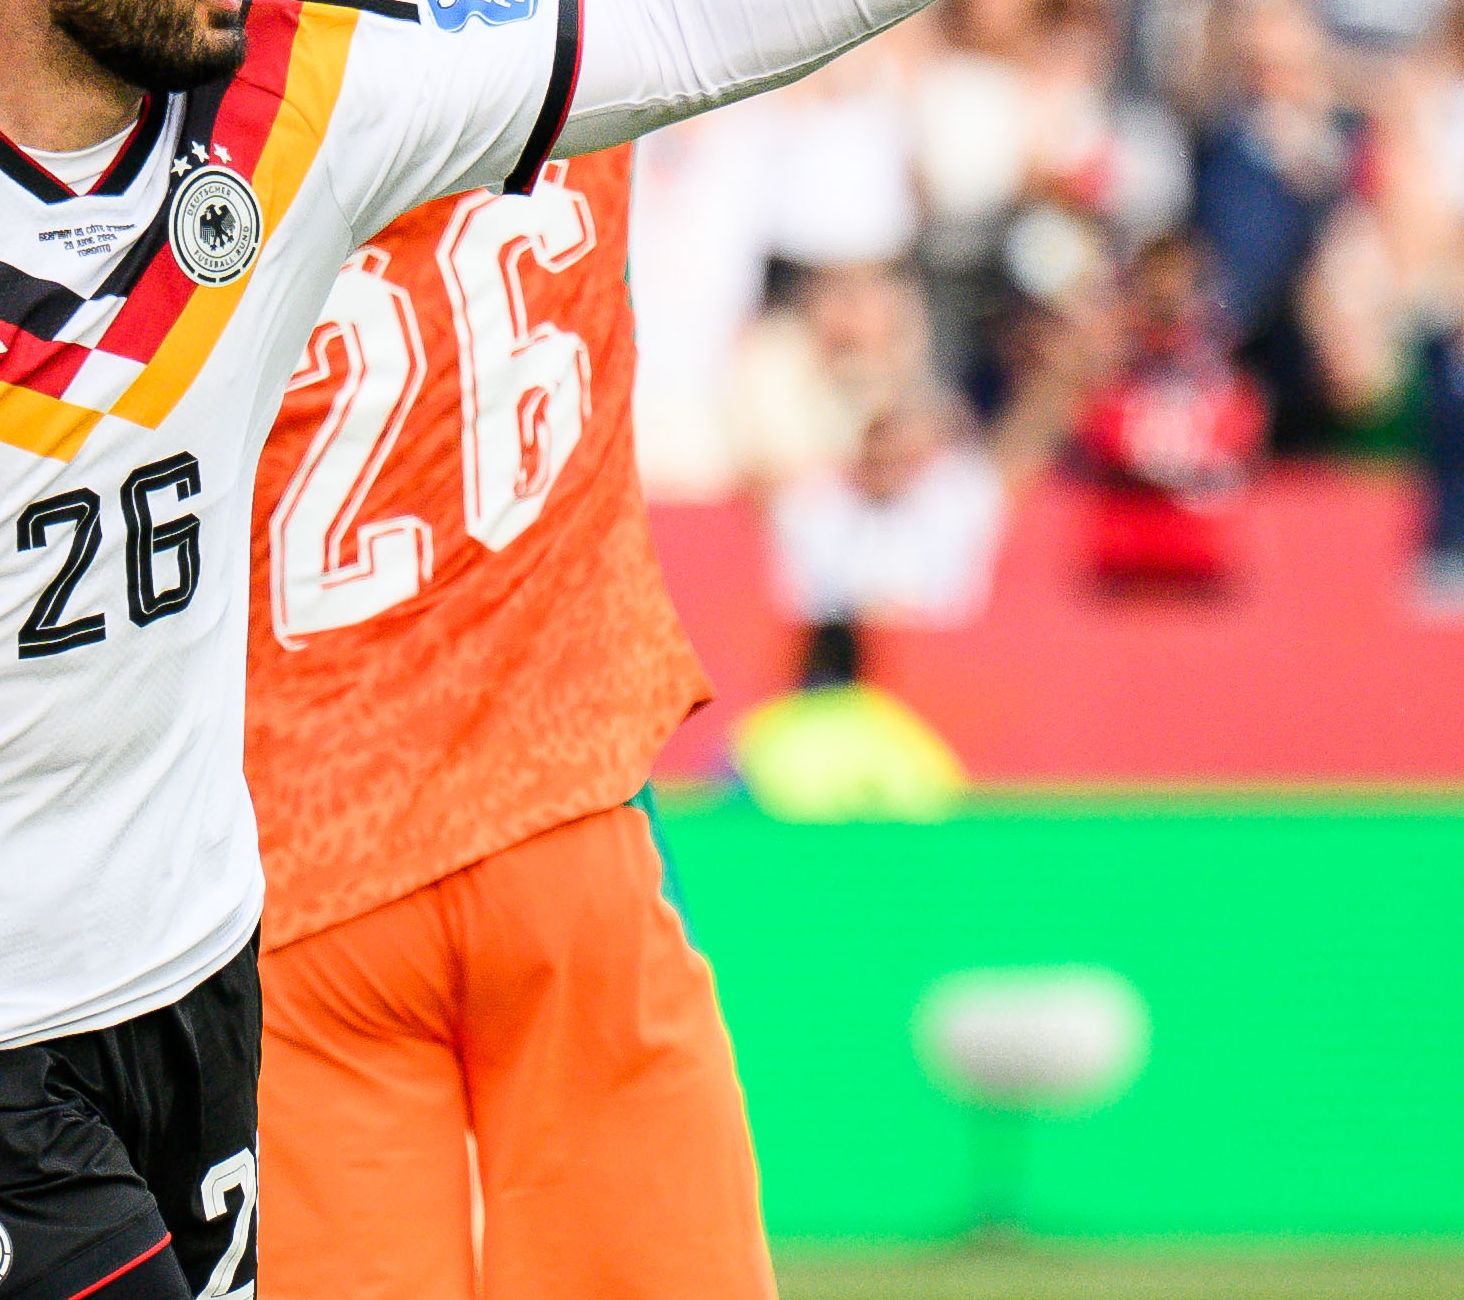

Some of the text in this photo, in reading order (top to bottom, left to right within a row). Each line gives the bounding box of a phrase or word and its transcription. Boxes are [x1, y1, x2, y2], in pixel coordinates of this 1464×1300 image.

[77, 243, 112, 257] TORONTO
[187, 185, 232, 217] DEUTSCHER
[268, 158, 598, 652] 26
[16, 450, 202, 660] 26
